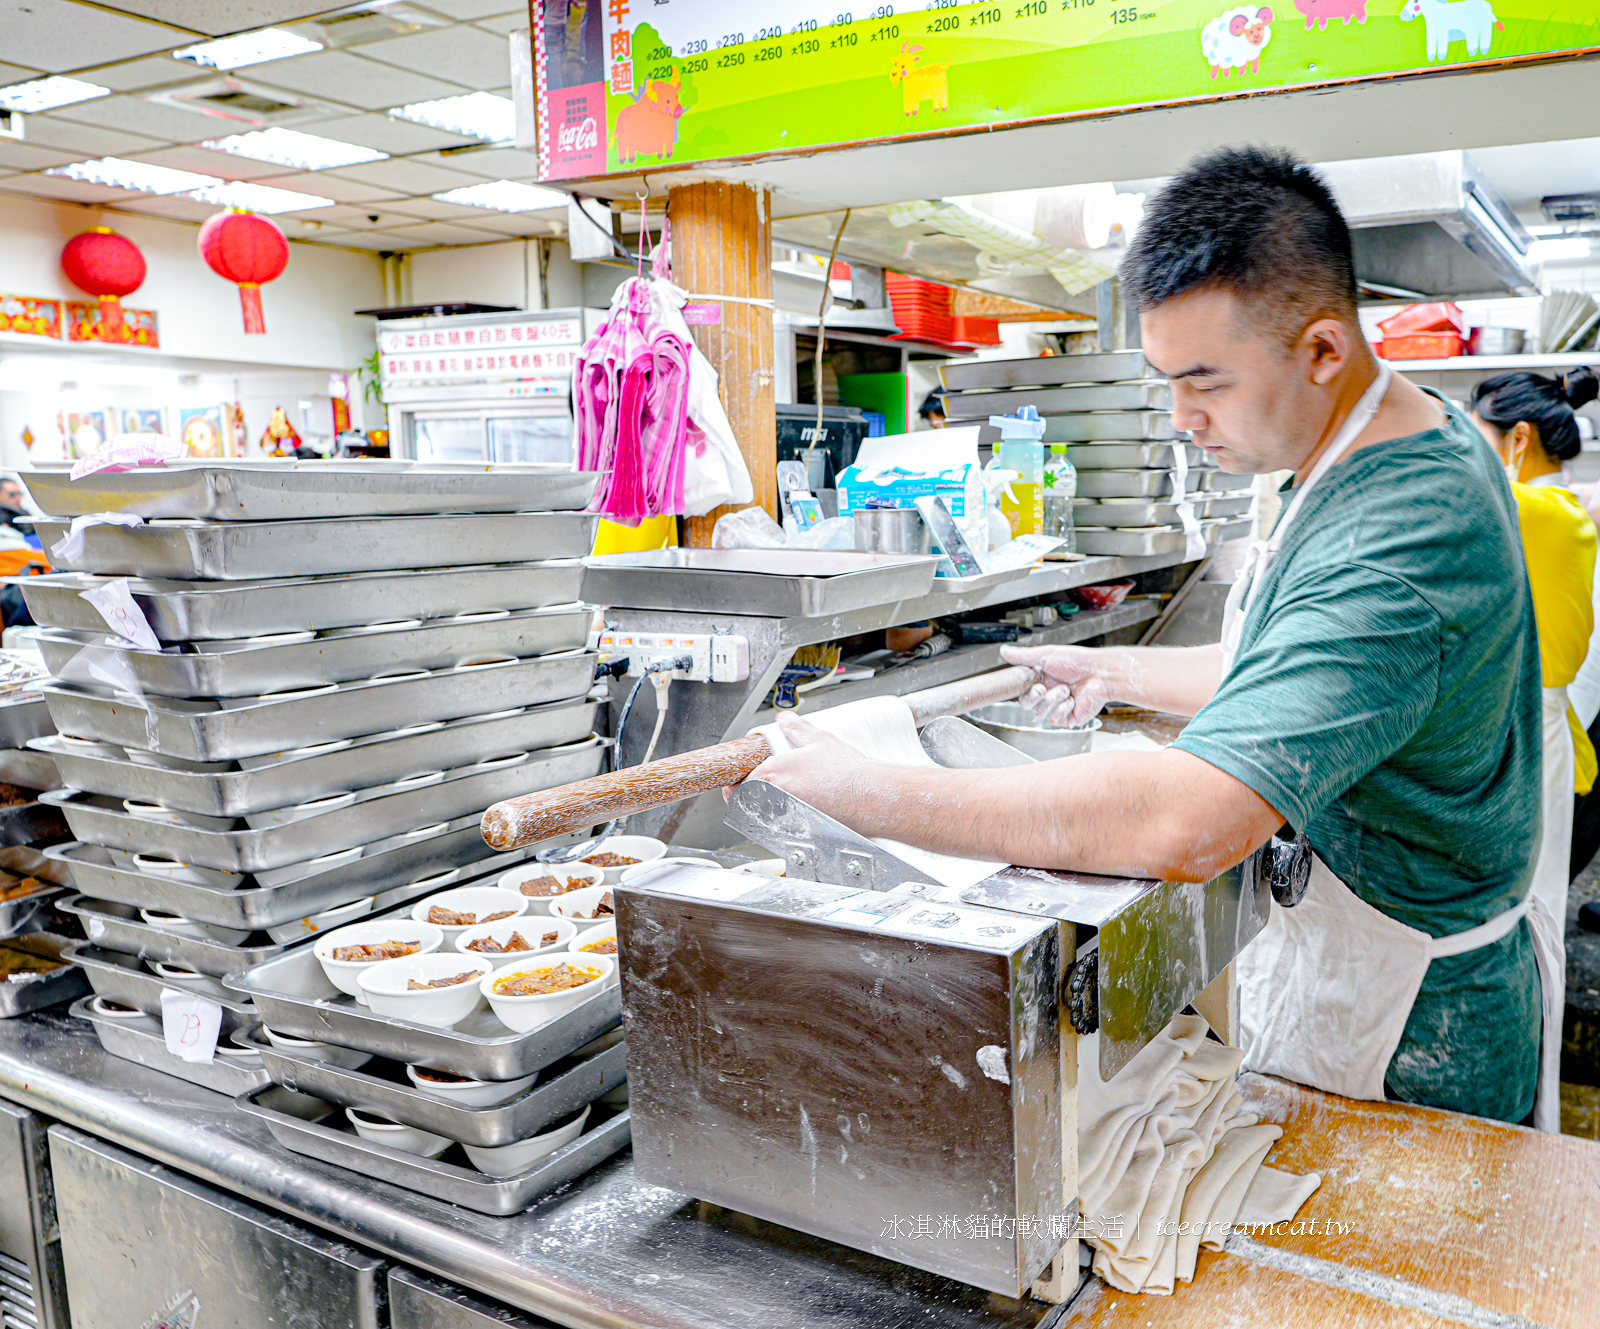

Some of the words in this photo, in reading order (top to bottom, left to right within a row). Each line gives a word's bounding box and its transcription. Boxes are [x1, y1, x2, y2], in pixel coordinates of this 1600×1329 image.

[1110, 7, 1138, 25] 135
[609, 0, 632, 94] 牛肉麵
